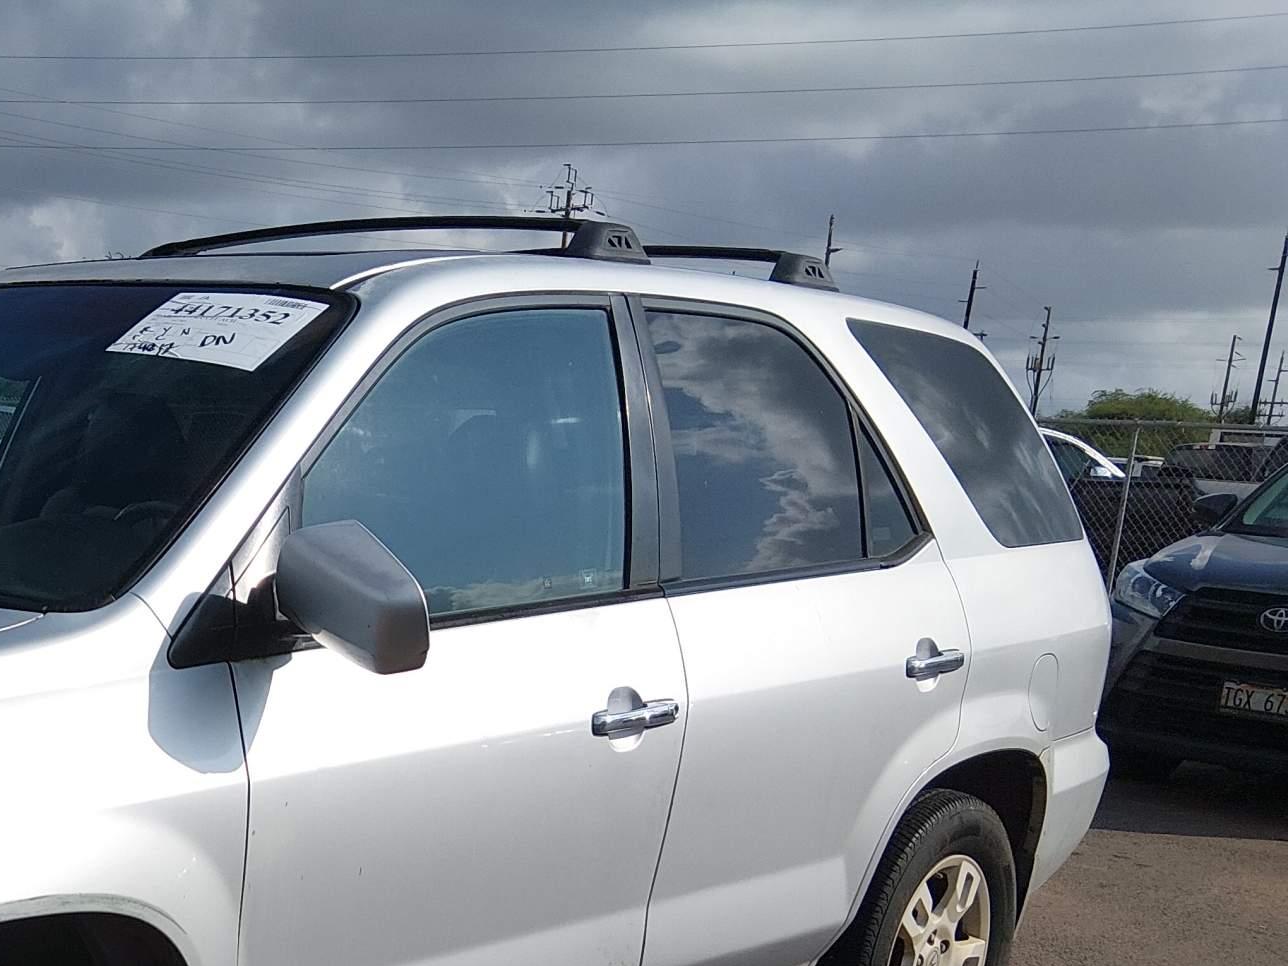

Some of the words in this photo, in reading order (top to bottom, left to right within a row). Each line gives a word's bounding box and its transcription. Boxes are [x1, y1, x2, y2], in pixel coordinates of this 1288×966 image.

[171, 303, 290, 325] 44171352
[198, 332, 236, 348] DN
[1264, 693, 1288, 713] 67
